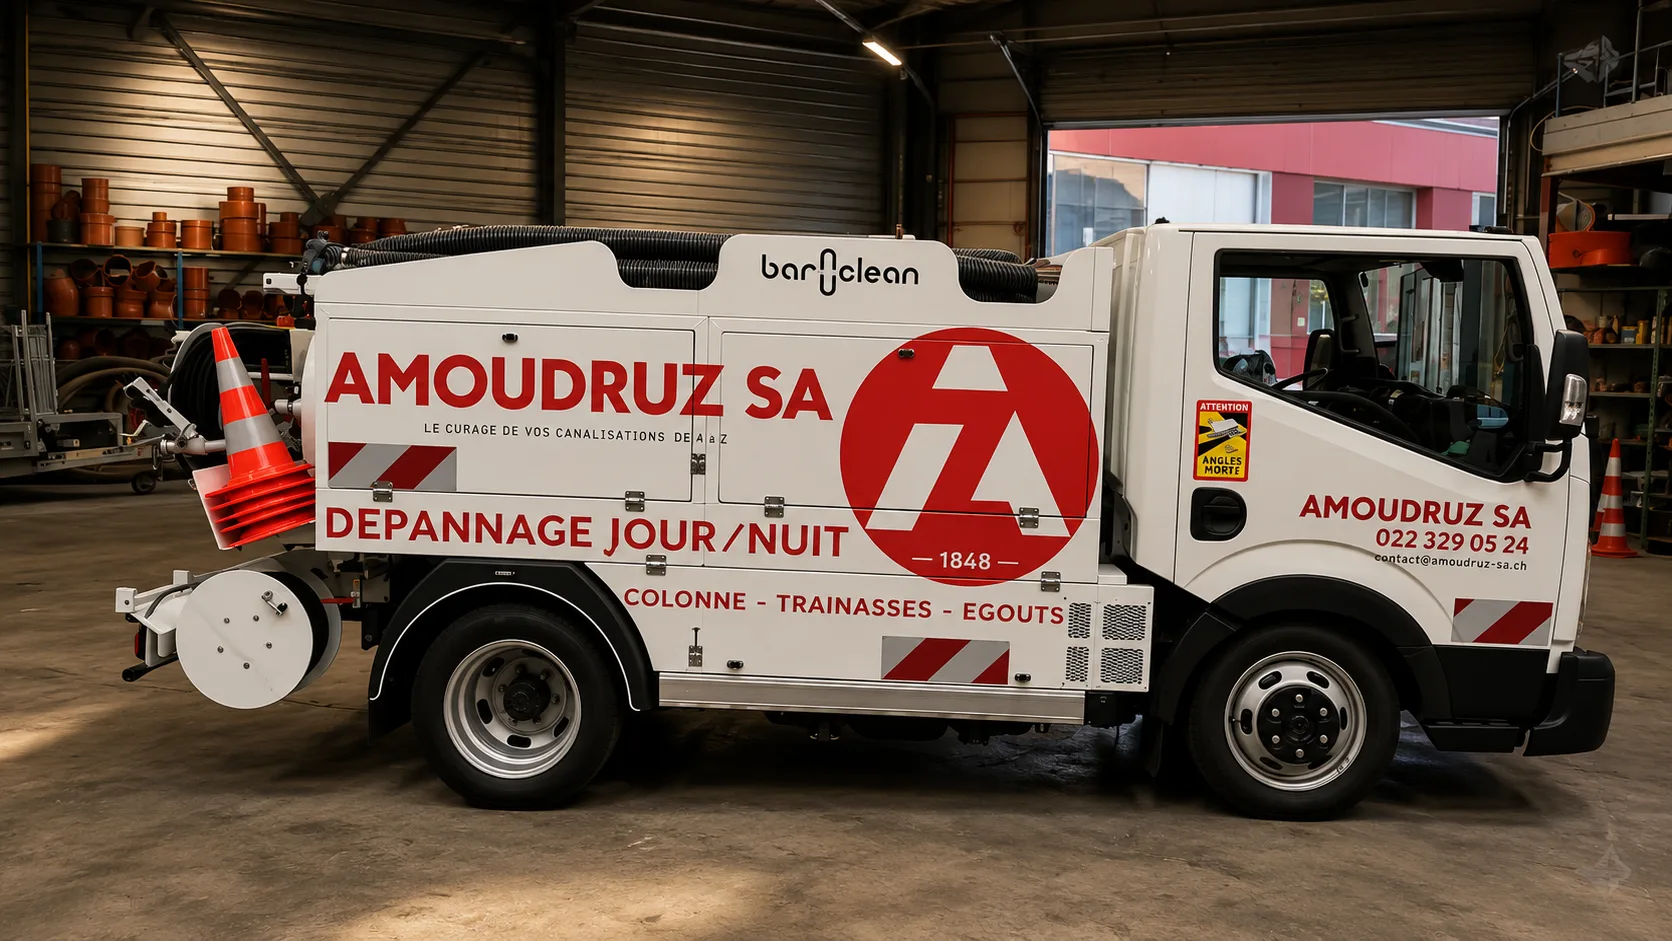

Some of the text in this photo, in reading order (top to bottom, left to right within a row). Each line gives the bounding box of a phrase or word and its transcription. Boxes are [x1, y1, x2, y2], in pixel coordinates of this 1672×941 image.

[324, 351, 834, 421] AMOUDRUZ SA
[1199, 402, 1249, 412] ATTENTION
[424, 423, 440, 434] LE
[445, 423, 497, 436] CURAGE
[502, 425, 518, 436] DE
[524, 426, 550, 438] VOS
[555, 427, 665, 442] CANALISATIONS
[674, 432, 691, 443] DE
[695, 433, 703, 443] A
[719, 433, 728, 444] Z
[1202, 456, 1242, 466] ANGLES
[1204, 465, 1240, 475] MORTE
[1299, 494, 1532, 529] AMOUDRUZ SA
[325, 506, 593, 549] DEPANNAGE
[1375, 528, 1529, 555] 022 329 05 24
[939, 551, 992, 570] 1848
[1374, 553, 1527, 571] contact@amoudruz-sa.ch
[623, 587, 747, 612] COLONNE
[776, 594, 932, 619] TRAINASSES
[963, 602, 1065, 625] EGOUTS
